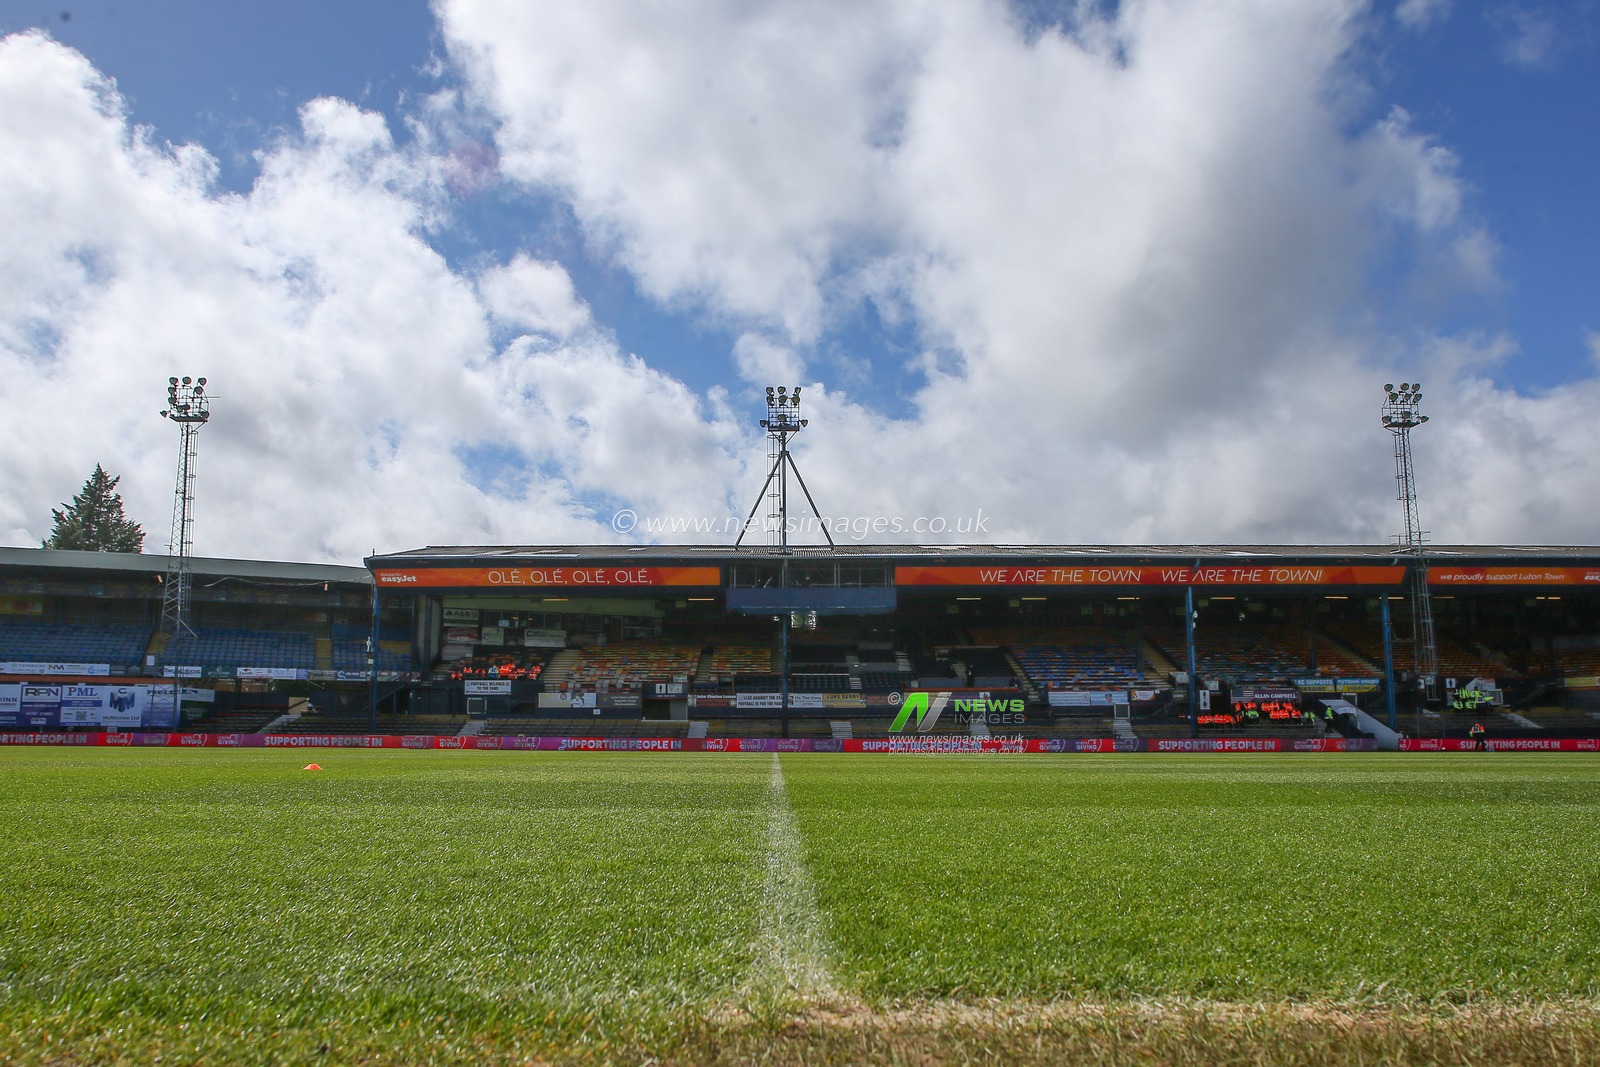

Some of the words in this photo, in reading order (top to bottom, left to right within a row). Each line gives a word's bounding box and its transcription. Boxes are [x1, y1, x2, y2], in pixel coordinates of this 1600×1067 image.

[381, 575, 417, 583] easyJet
[488, 569, 526, 584] OLÉ,
[530, 569, 568, 584] OLÉ,
[572, 569, 610, 584] OLÉ,
[614, 569, 652, 584] OLÉ,
[980, 570, 1007, 582] WE
[1012, 570, 1046, 582] ARE
[1052, 570, 1083, 582] THE
[1089, 570, 1142, 582] TOWN
[1161, 570, 1188, 582] WE
[1192, 570, 1226, 582] ARE
[1232, 570, 1263, 582] THE
[1269, 570, 1323, 582] TOWN!
[1453, 572, 1484, 582] proudly
[1486, 572, 1517, 582] support
[1544, 572, 1564, 580] Town
[25, 688, 59, 697] RPN
[68, 687, 98, 697] PML
[35, 734, 75, 743] PEOPLE
[76, 734, 87, 743] IN
[264, 736, 330, 746] SUPPORTING
[331, 737, 370, 746] PEOPLE
[371, 737, 383, 747] IN
[562, 739, 628, 749] SUPPORTING
[629, 740, 670, 749] PEOPLE
[671, 740, 682, 749] IN
[862, 741, 929, 750] SUPPORTING
[931, 741, 970, 751] PEOPLE
[1158, 740, 1223, 750] SUPPORTING
[1224, 740, 1264, 750] PEOPLE
[1264, 740, 1275, 749] IN
[1460, 740, 1515, 749] SUPORTING
[1516, 740, 1550, 749] PEOPLE
[1551, 740, 1560, 749] IN
